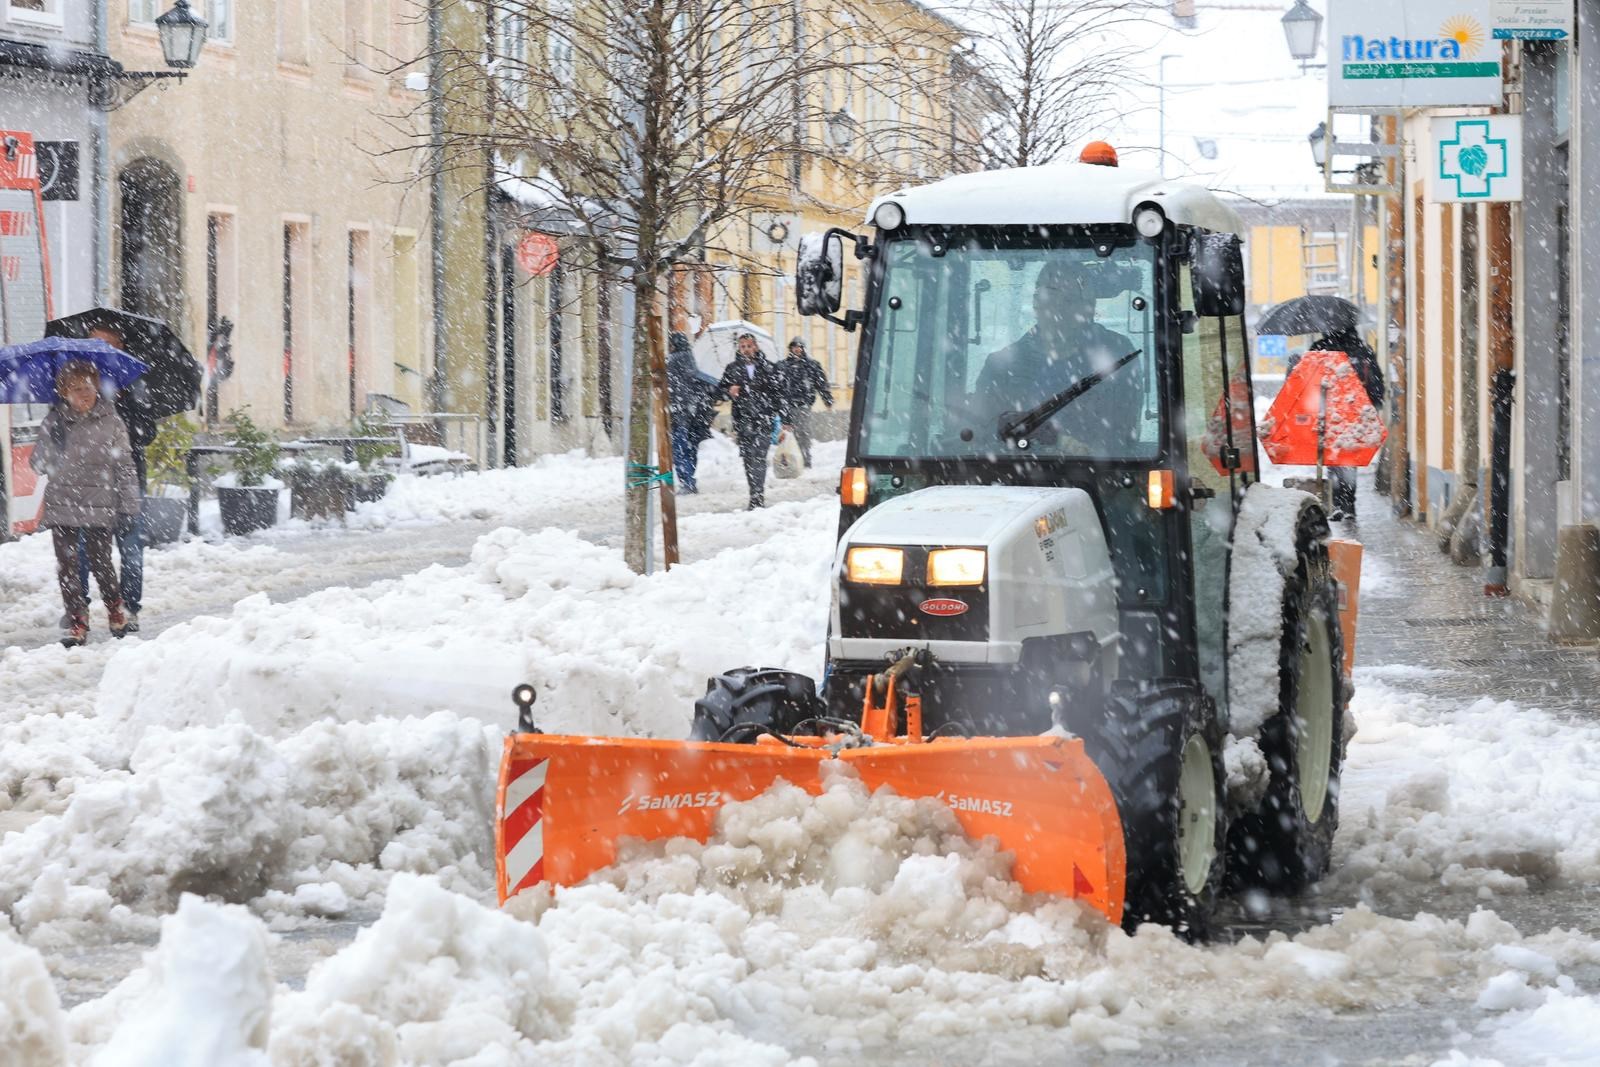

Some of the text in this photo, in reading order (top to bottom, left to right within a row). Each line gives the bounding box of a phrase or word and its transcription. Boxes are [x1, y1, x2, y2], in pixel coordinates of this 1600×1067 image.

[1342, 34, 1460, 60] natura
[922, 603, 965, 611] GOLDONI
[637, 791, 720, 810] SaMASZ
[948, 794, 1014, 817] SaMASZ
